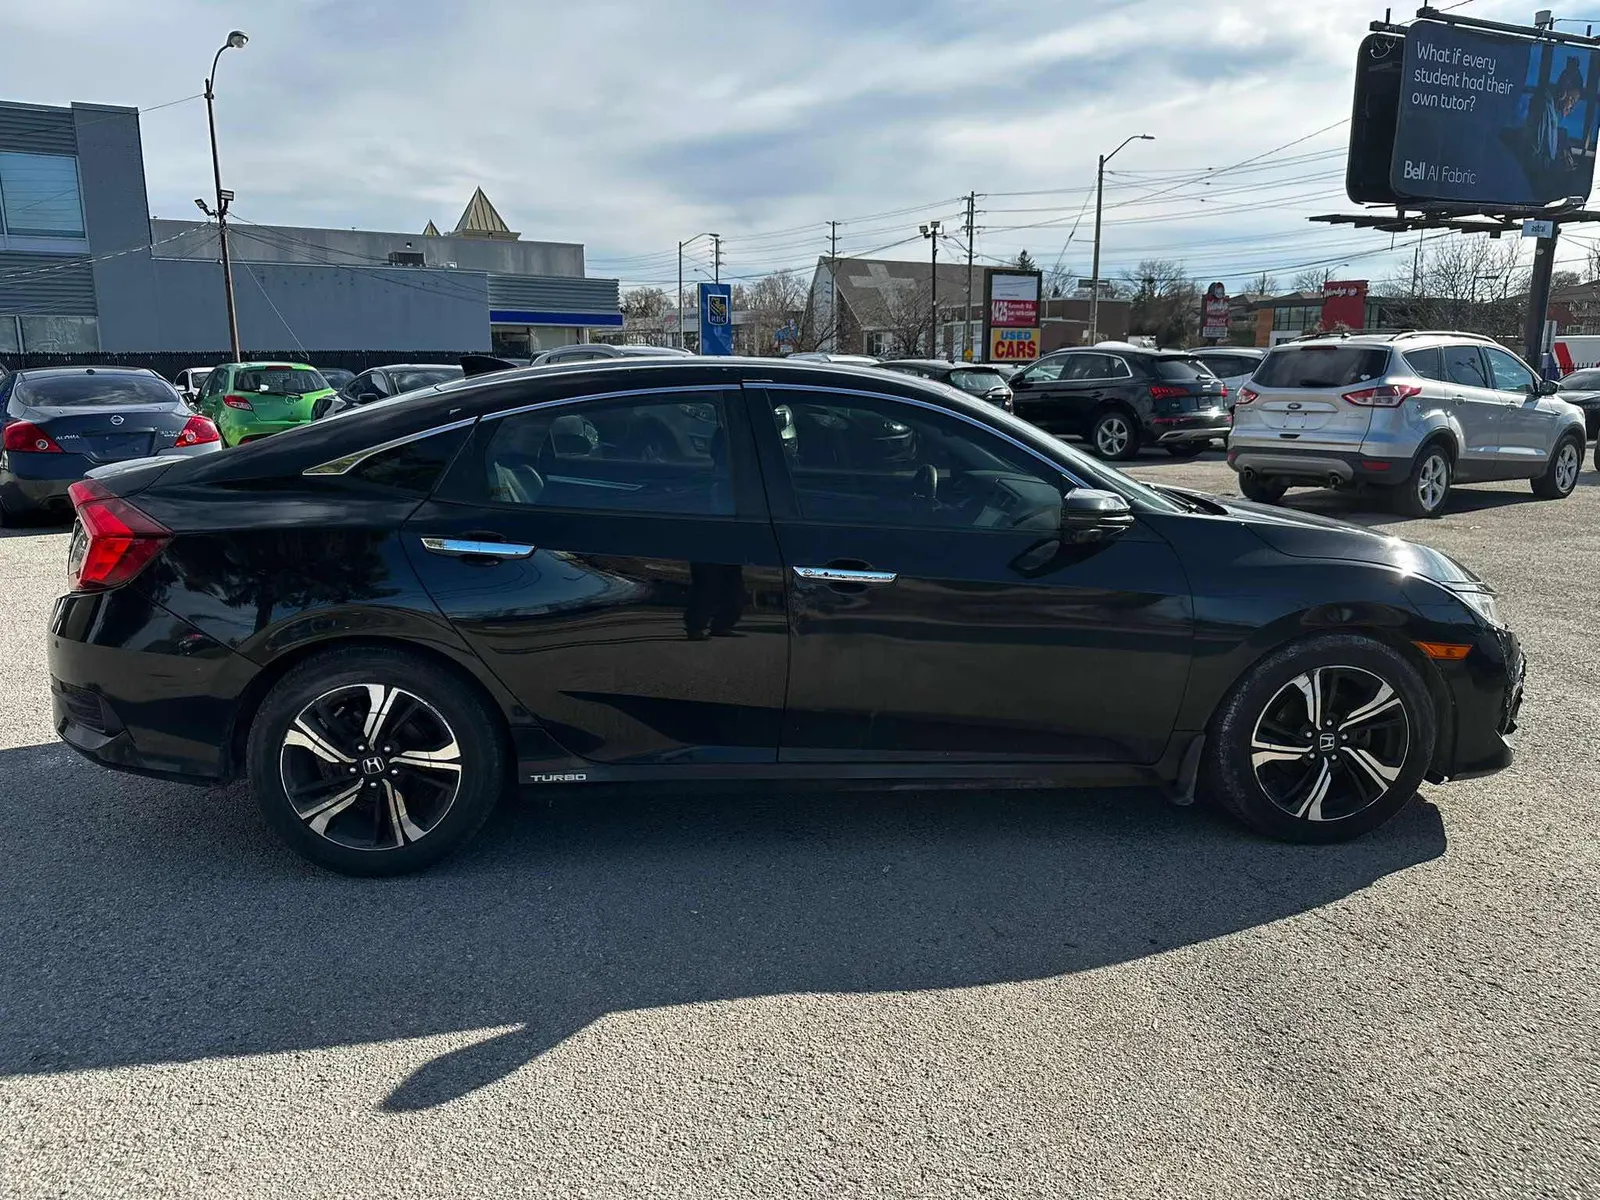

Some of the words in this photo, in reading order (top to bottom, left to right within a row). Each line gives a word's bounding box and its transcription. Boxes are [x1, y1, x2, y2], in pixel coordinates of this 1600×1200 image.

[1417, 41, 1450, 63] What
[1452, 47, 1462, 65] if
[1463, 54, 1496, 75] every
[1414, 67, 1460, 88] student
[1461, 72, 1485, 91] had
[1486, 76, 1514, 95] their
[1411, 92, 1438, 107] own
[1440, 93, 1476, 112] tutor?
[1403, 160, 1426, 180] Bell
[1427, 165, 1439, 181] AI
[1441, 165, 1477, 185] Fabric
[991, 301, 1008, 321] 1425
[1001, 331, 1031, 340] USED
[995, 341, 1036, 358] CARS
[530, 773, 587, 782] TURBO
